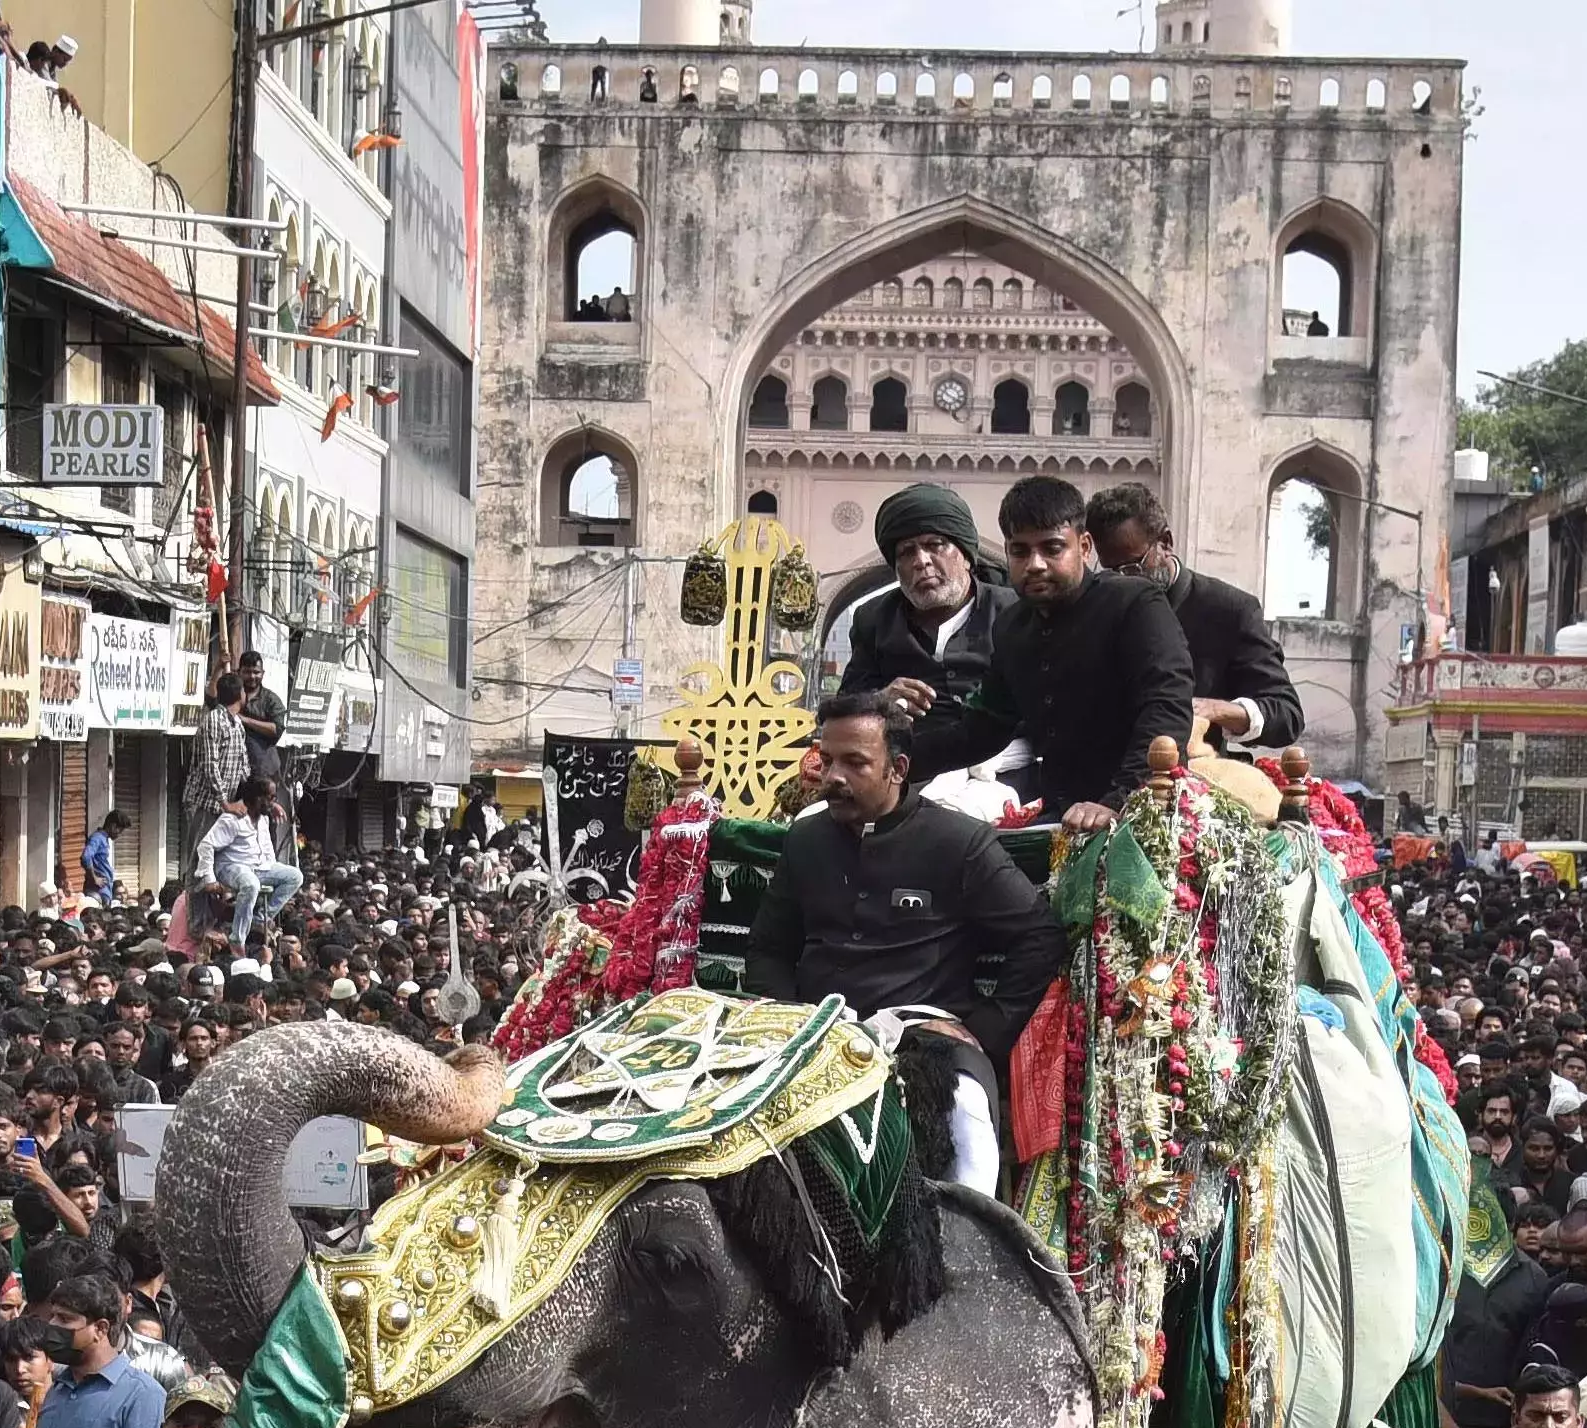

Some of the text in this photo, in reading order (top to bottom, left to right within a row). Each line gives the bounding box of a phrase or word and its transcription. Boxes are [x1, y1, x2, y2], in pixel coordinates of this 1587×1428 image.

[50, 409, 153, 449] MODI
[49, 452, 151, 478] PEARLS
[89, 624, 132, 726] Rasheed
[135, 656, 142, 691] &
[145, 656, 166, 693] Sons
